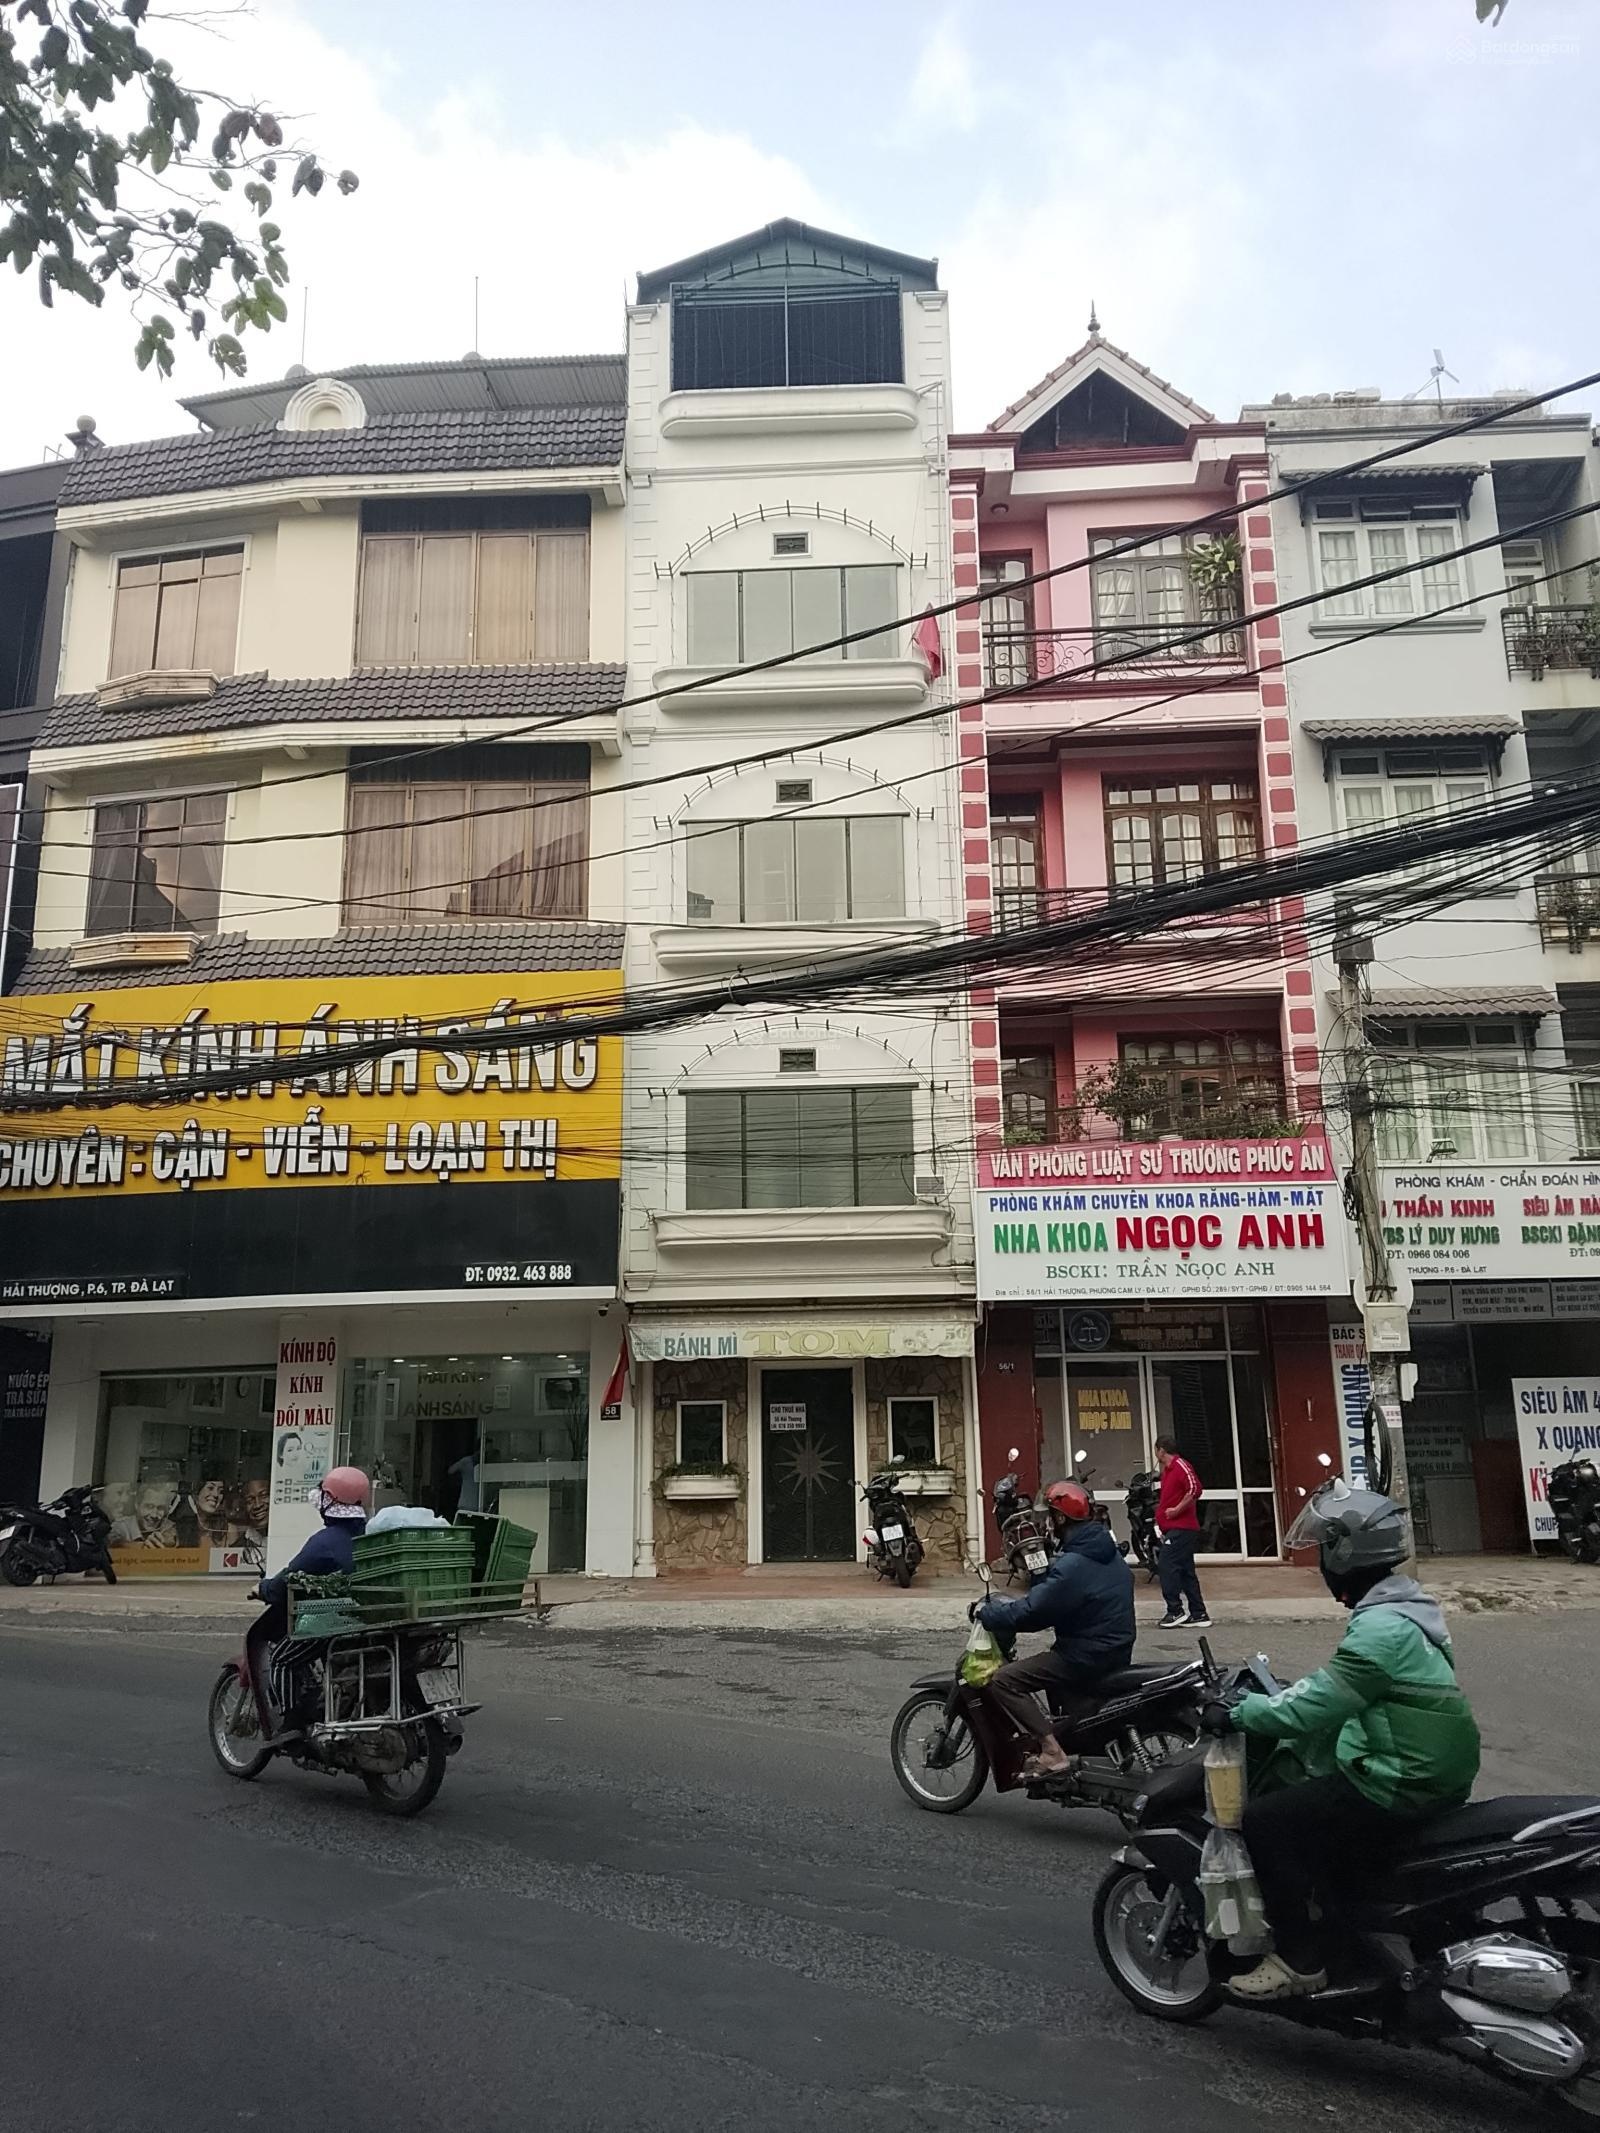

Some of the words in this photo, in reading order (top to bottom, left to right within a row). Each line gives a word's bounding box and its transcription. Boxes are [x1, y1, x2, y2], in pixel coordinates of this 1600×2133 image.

[434, 997, 599, 1093] SÁNG
[151, 1118, 230, 1190] CẬN
[263, 1105, 350, 1177] VIỄN
[384, 1120, 487, 1183] LOẠN
[499, 1119, 558, 1179] THỊ
[1028, 1145, 1087, 1178] PHÒNG
[1092, 1144, 1133, 1182] LUẬT
[1140, 1143, 1164, 1176] SƯ
[1247, 1140, 1293, 1173] PHÚC
[1300, 1140, 1325, 1172] ÂN
[1396, 1173, 1441, 1188] PHÒNG
[1446, 1174, 1484, 1188] KHÁM
[1542, 1172, 1579, 1186] ĐOÁN
[990, 1192, 1038, 1213] PHÒNG
[1042, 1189, 1087, 1212] KHÁM
[1091, 1188, 1149, 1210] CHUYÊN
[1155, 1190, 1195, 1209] KHOA
[1394, 1194, 1443, 1218] THẦN
[1451, 1199, 1495, 1217] KINH
[1523, 1195, 1550, 1217] SIÊU
[1554, 1194, 1575, 1216] ÂM
[1580, 1194, 1600, 1216] MÀ
[994, 1222, 1041, 1254] NHA
[1047, 1221, 1108, 1252] KHOA
[1116, 1213, 1222, 1260] NGỌC
[1238, 1212, 1325, 1249] ANH
[1409, 1223, 1424, 1245] LÝ
[1429, 1226, 1456, 1245] DUY
[1461, 1225, 1500, 1244] HƯNG
[1568, 1222, 1600, 1246] ĐẶN
[1408, 1250, 1430, 1259] 0966
[1433, 1250, 1450, 1259] 084
[1453, 1250, 1470, 1258] 006
[465, 1267, 484, 1282] ĐT:
[487, 1266, 520, 1281] 0932.
[523, 1265, 546, 1281] 463
[549, 1264, 572, 1280] 888
[1116, 1257, 1167, 1278] TRẦN
[1176, 1262, 1227, 1280] NGỌC
[1235, 1262, 1275, 1277] ANH
[3, 1282, 25, 1297] HẢI
[112, 1282, 127, 1293] TP.
[131, 1278, 149, 1292] ĐÀ
[153, 1280, 174, 1295] LẠT
[664, 1332, 711, 1356] BÁNH
[718, 1332, 738, 1355] MÌ
[742, 1328, 892, 1355] TOM
[1332, 1326, 1355, 1340] BÁC
[1359, 1328, 1366, 1340] S
[280, 1337, 314, 1364] KÍNH
[317, 1336, 336, 1366] ĐỘ
[8, 1369, 37, 1388] NƯỚC
[37, 1371, 50, 1388] ÉP
[289, 1373, 324, 1394] KÍNH
[605, 1406, 617, 1415] 58
[1521, 1386, 1558, 1415] SIÊU
[1563, 1386, 1588, 1413] ÂM
[276, 1402, 300, 1427] ĐỔI
[304, 1404, 334, 1426] MÀU
[1536, 1426, 1549, 1449] X
